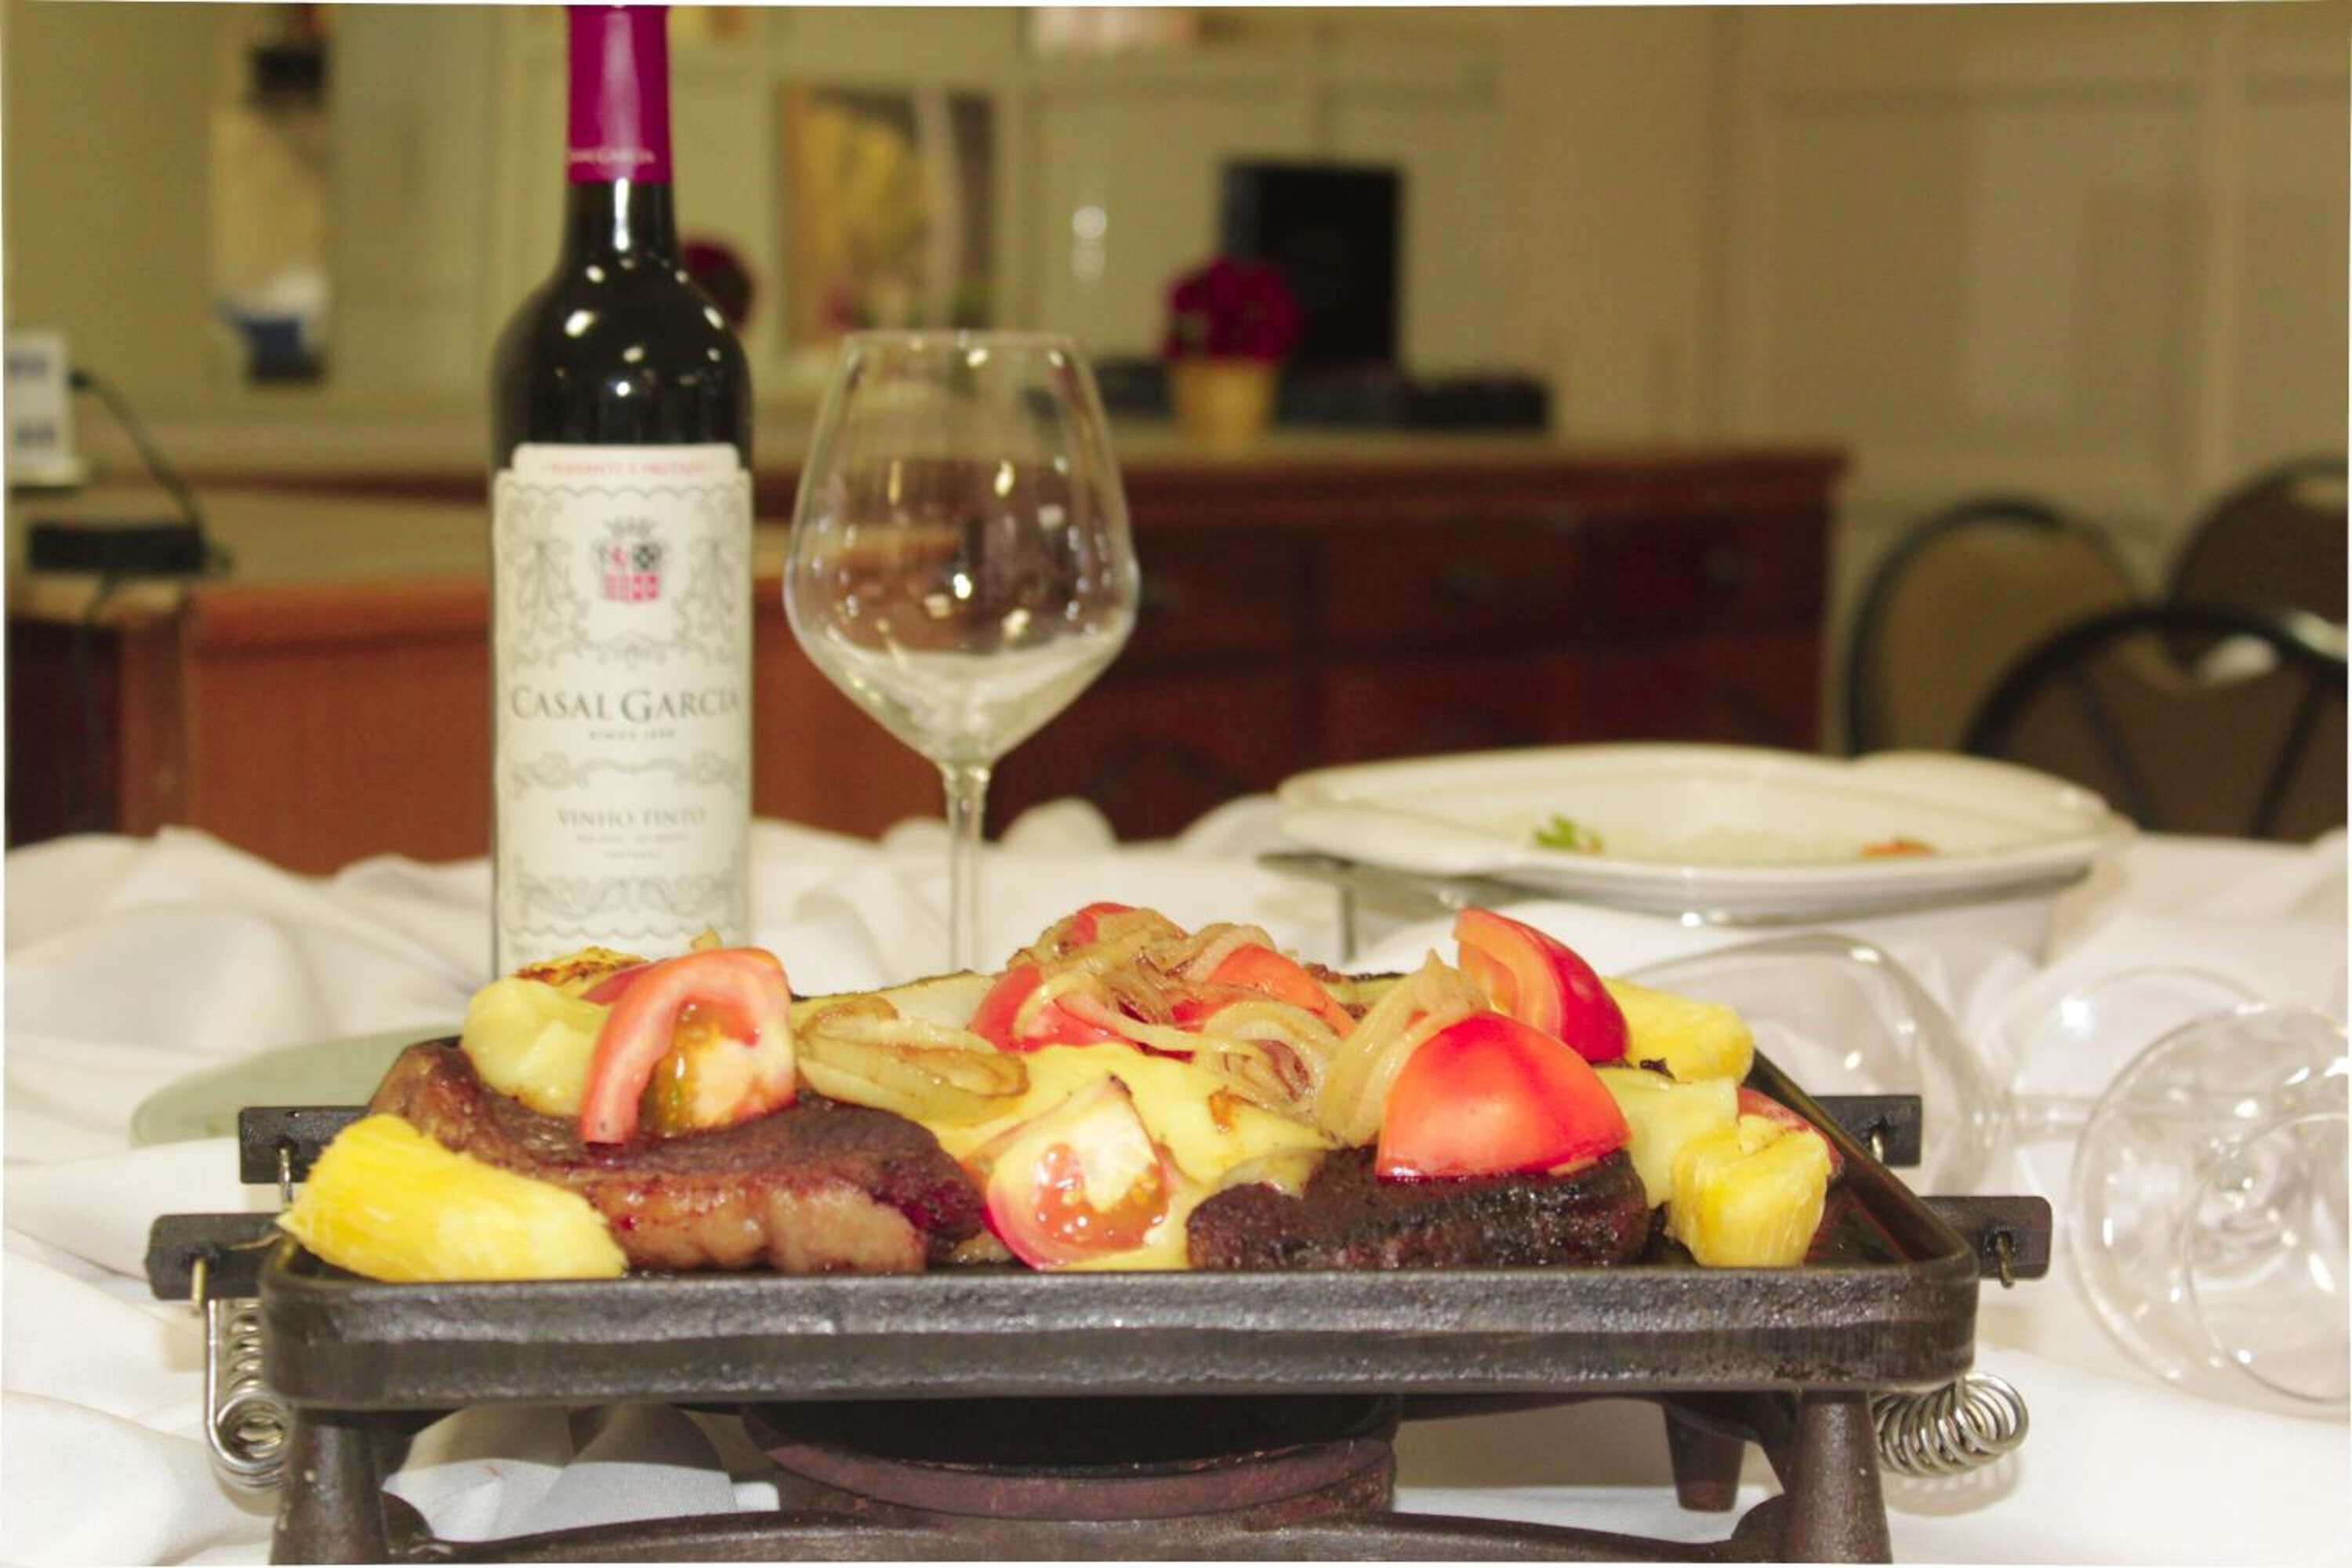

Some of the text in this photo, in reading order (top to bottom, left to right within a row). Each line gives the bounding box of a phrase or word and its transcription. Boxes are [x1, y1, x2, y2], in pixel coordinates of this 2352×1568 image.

[510, 684, 741, 723] CASAL GARCIA
[556, 805, 707, 828] VINHO TINTO
